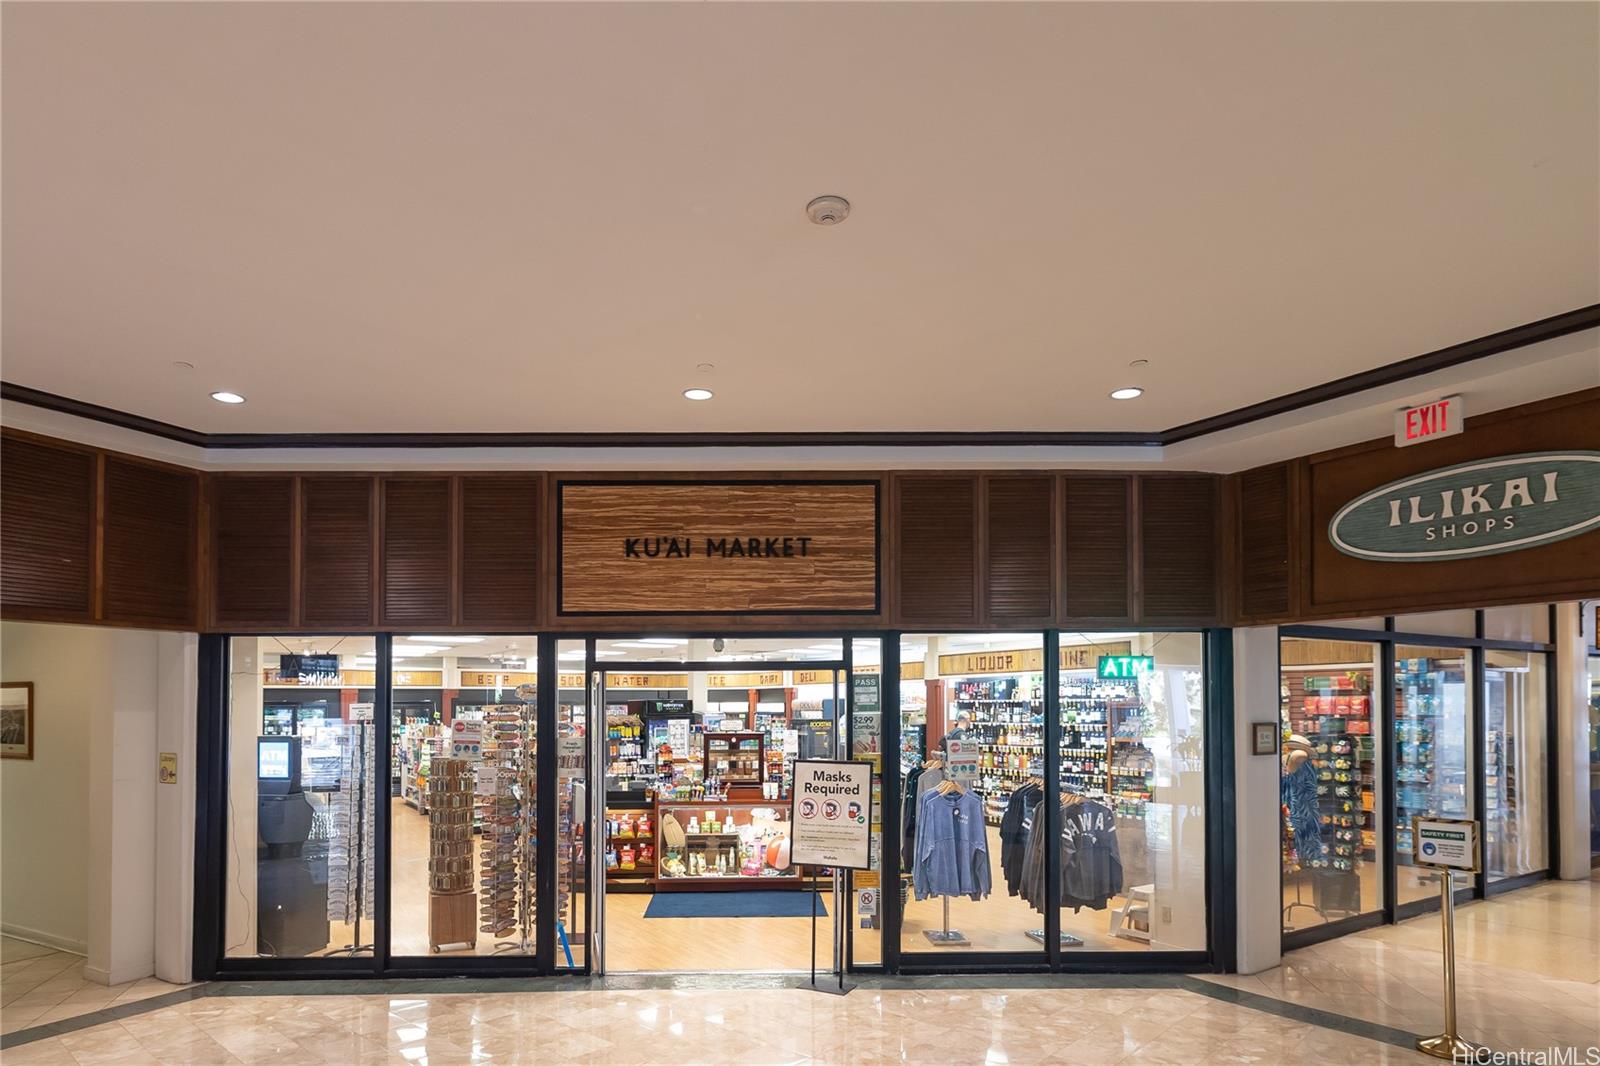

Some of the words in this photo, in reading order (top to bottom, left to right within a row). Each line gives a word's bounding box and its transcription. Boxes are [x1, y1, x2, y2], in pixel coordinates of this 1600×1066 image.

[1406, 400, 1450, 440] EXIT
[1389, 471, 1559, 527] ILIKAI
[1425, 515, 1515, 541] SHOPS
[705, 537, 812, 558] MARKET
[967, 655, 1014, 672] LIQUOR
[1103, 657, 1150, 677] ATM
[477, 674, 509, 684] BER
[613, 676, 649, 686] WATER
[709, 676, 726, 686] ICE
[800, 672, 817, 682] DELI
[813, 770, 852, 783] Masks
[804, 782, 860, 796] Required
